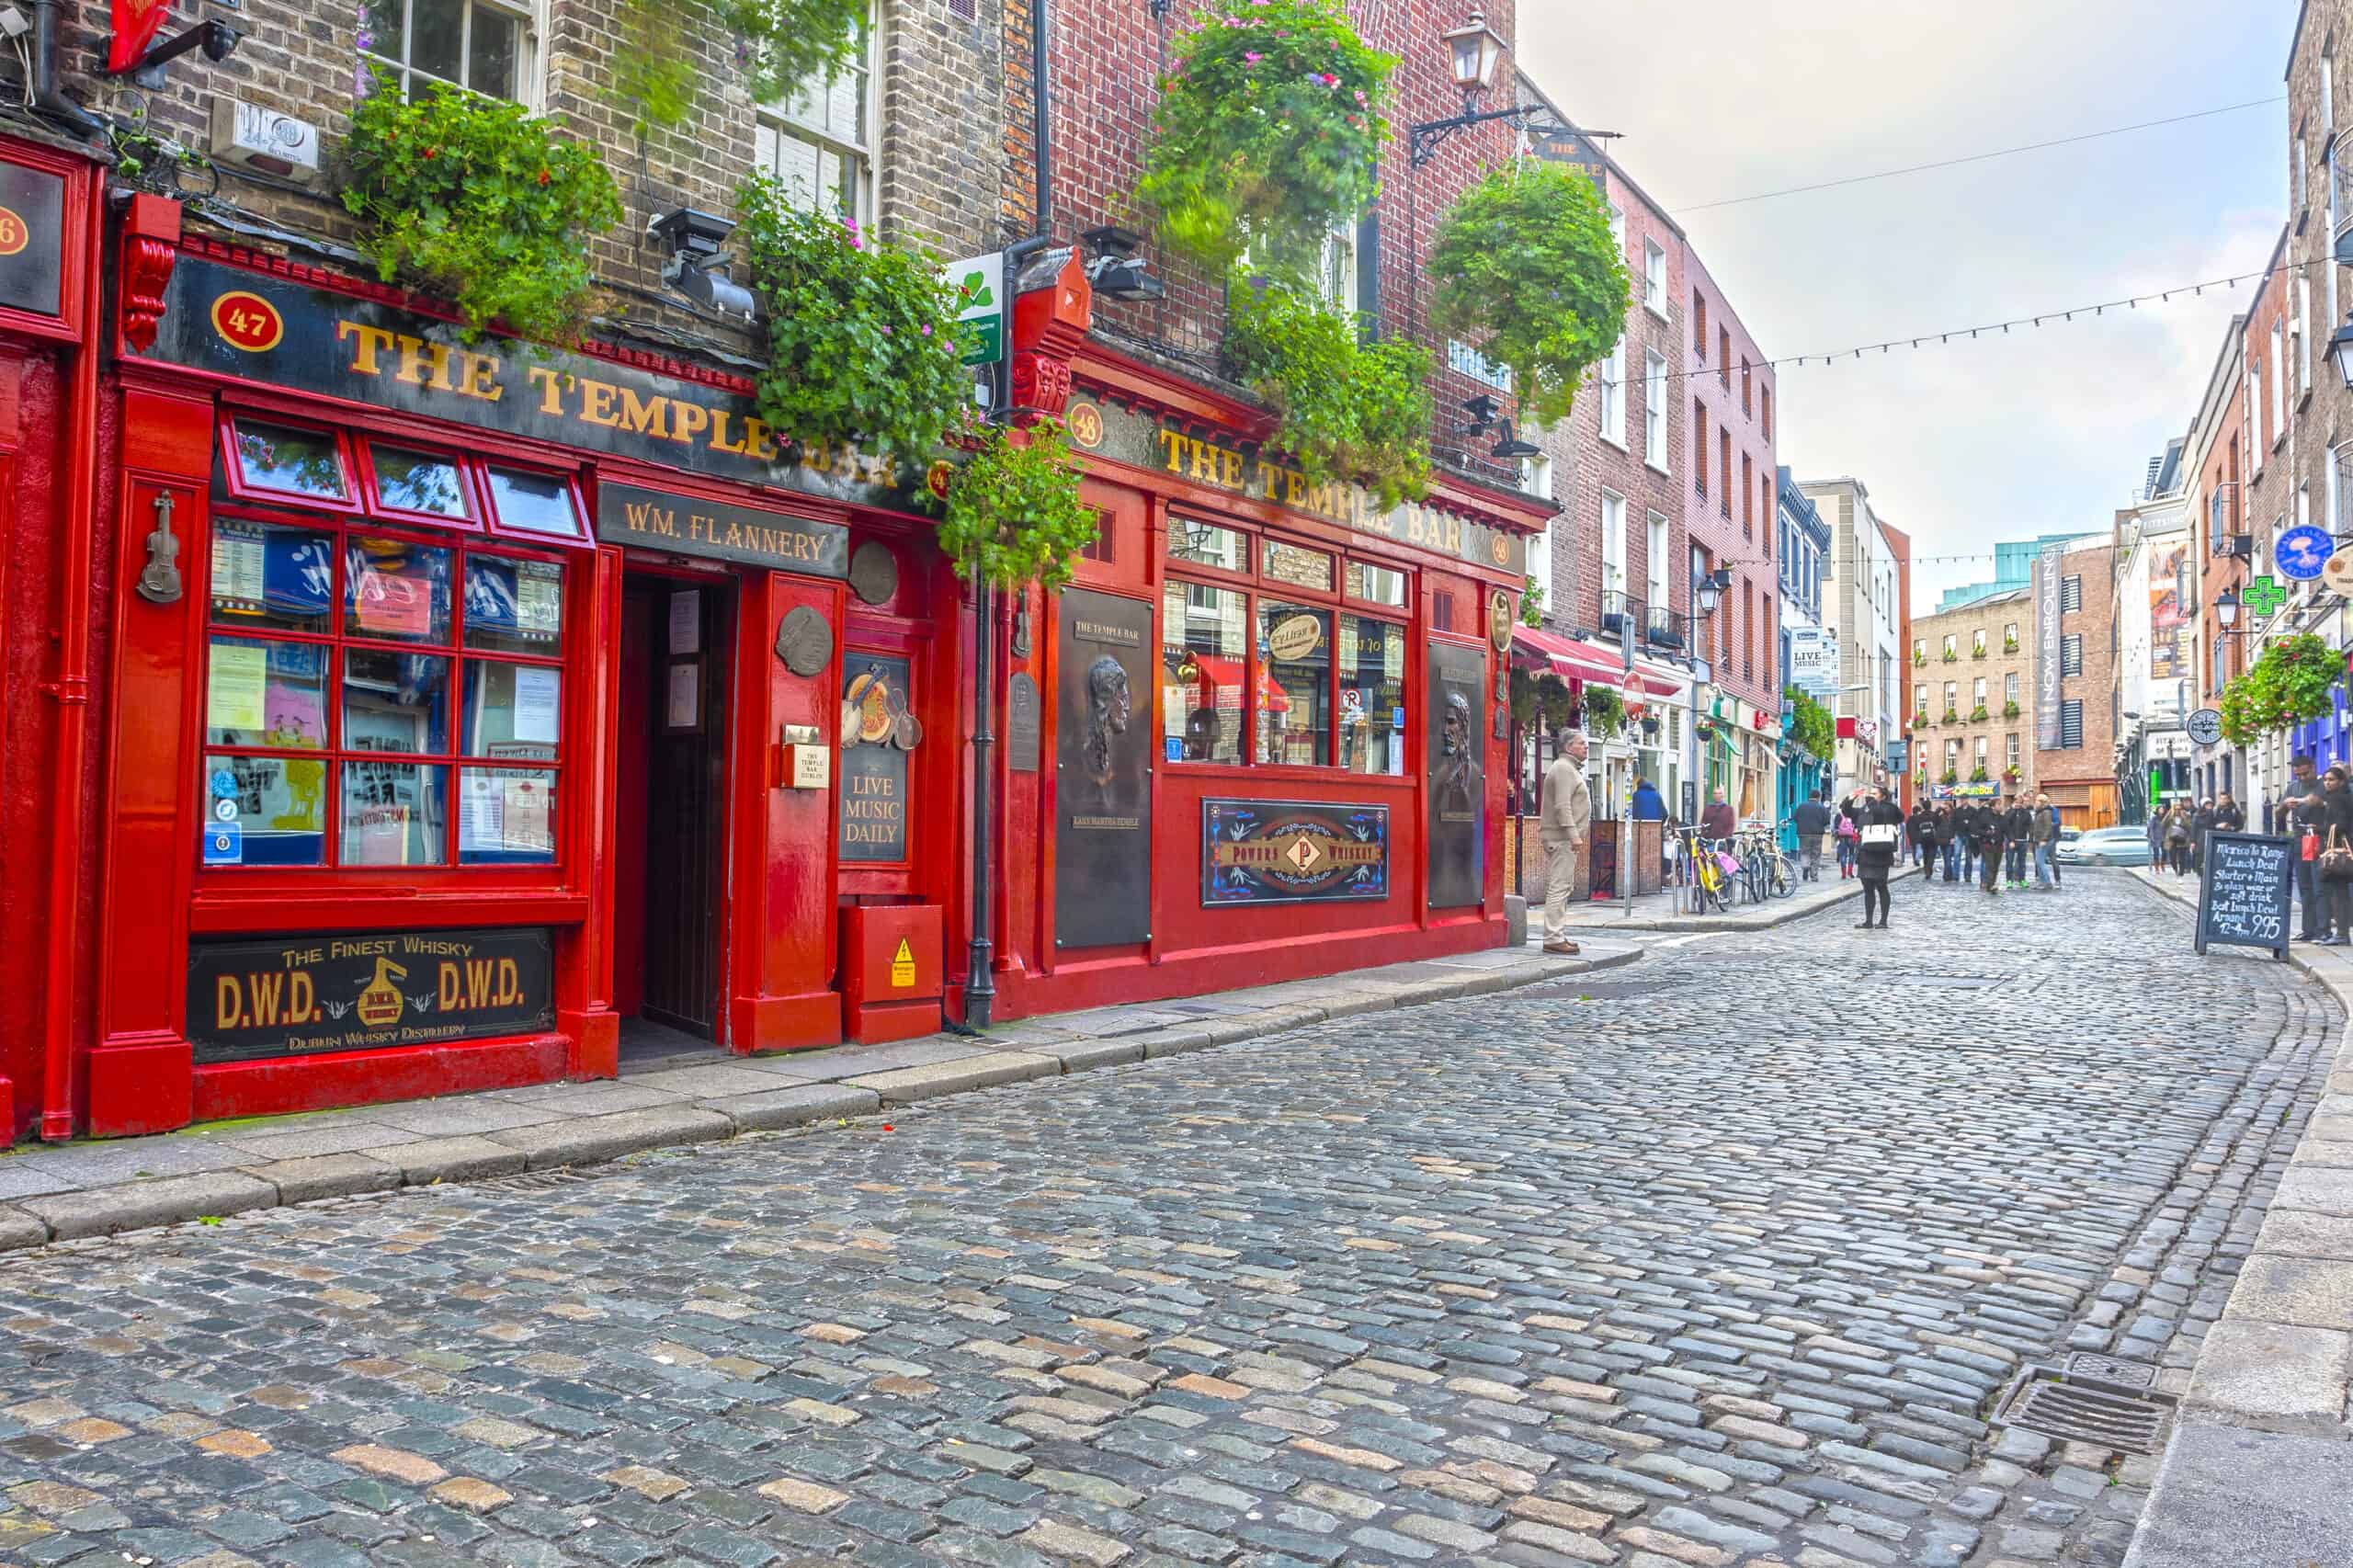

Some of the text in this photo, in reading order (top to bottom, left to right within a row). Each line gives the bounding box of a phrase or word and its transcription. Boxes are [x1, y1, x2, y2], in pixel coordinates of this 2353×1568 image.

[0, 218, 16, 244] 6
[228, 309, 267, 337] 47
[337, 320, 504, 403] THE
[528, 366, 779, 461] TEMPLE
[1075, 413, 1096, 442] 48
[1161, 429, 1245, 491] THE
[1407, 504, 1462, 552] BAR
[625, 502, 826, 562] WM. FLANNERY
[1495, 539, 1508, 558] 48
[1074, 620, 1140, 641] THE TEMPLE BAR
[2042, 548, 2056, 701] NOW ENROLLING
[1793, 652, 1822, 661] LIVE
[1793, 660, 1822, 669] MUSIC
[852, 775, 893, 796] LIVE
[845, 799, 900, 820] MUSIC
[845, 823, 897, 843] DAILY
[1233, 845, 1279, 863] POWERS
[1298, 841, 1310, 868] P
[2225, 857, 2278, 870] Lunch Deal
[2213, 869, 2247, 881] Starter
[2255, 871, 2279, 883] Main
[2230, 891, 2272, 903] soft drink
[2231, 901, 2256, 913] Lunch
[2256, 903, 2278, 915] Deal
[282, 936, 474, 969] THE FINEST WHISKY
[438, 958, 525, 1012] D.W.D.
[216, 971, 323, 1030] D.W.D.
[289, 1025, 466, 1051] DUBLIN WHISKY DISTILLERY
